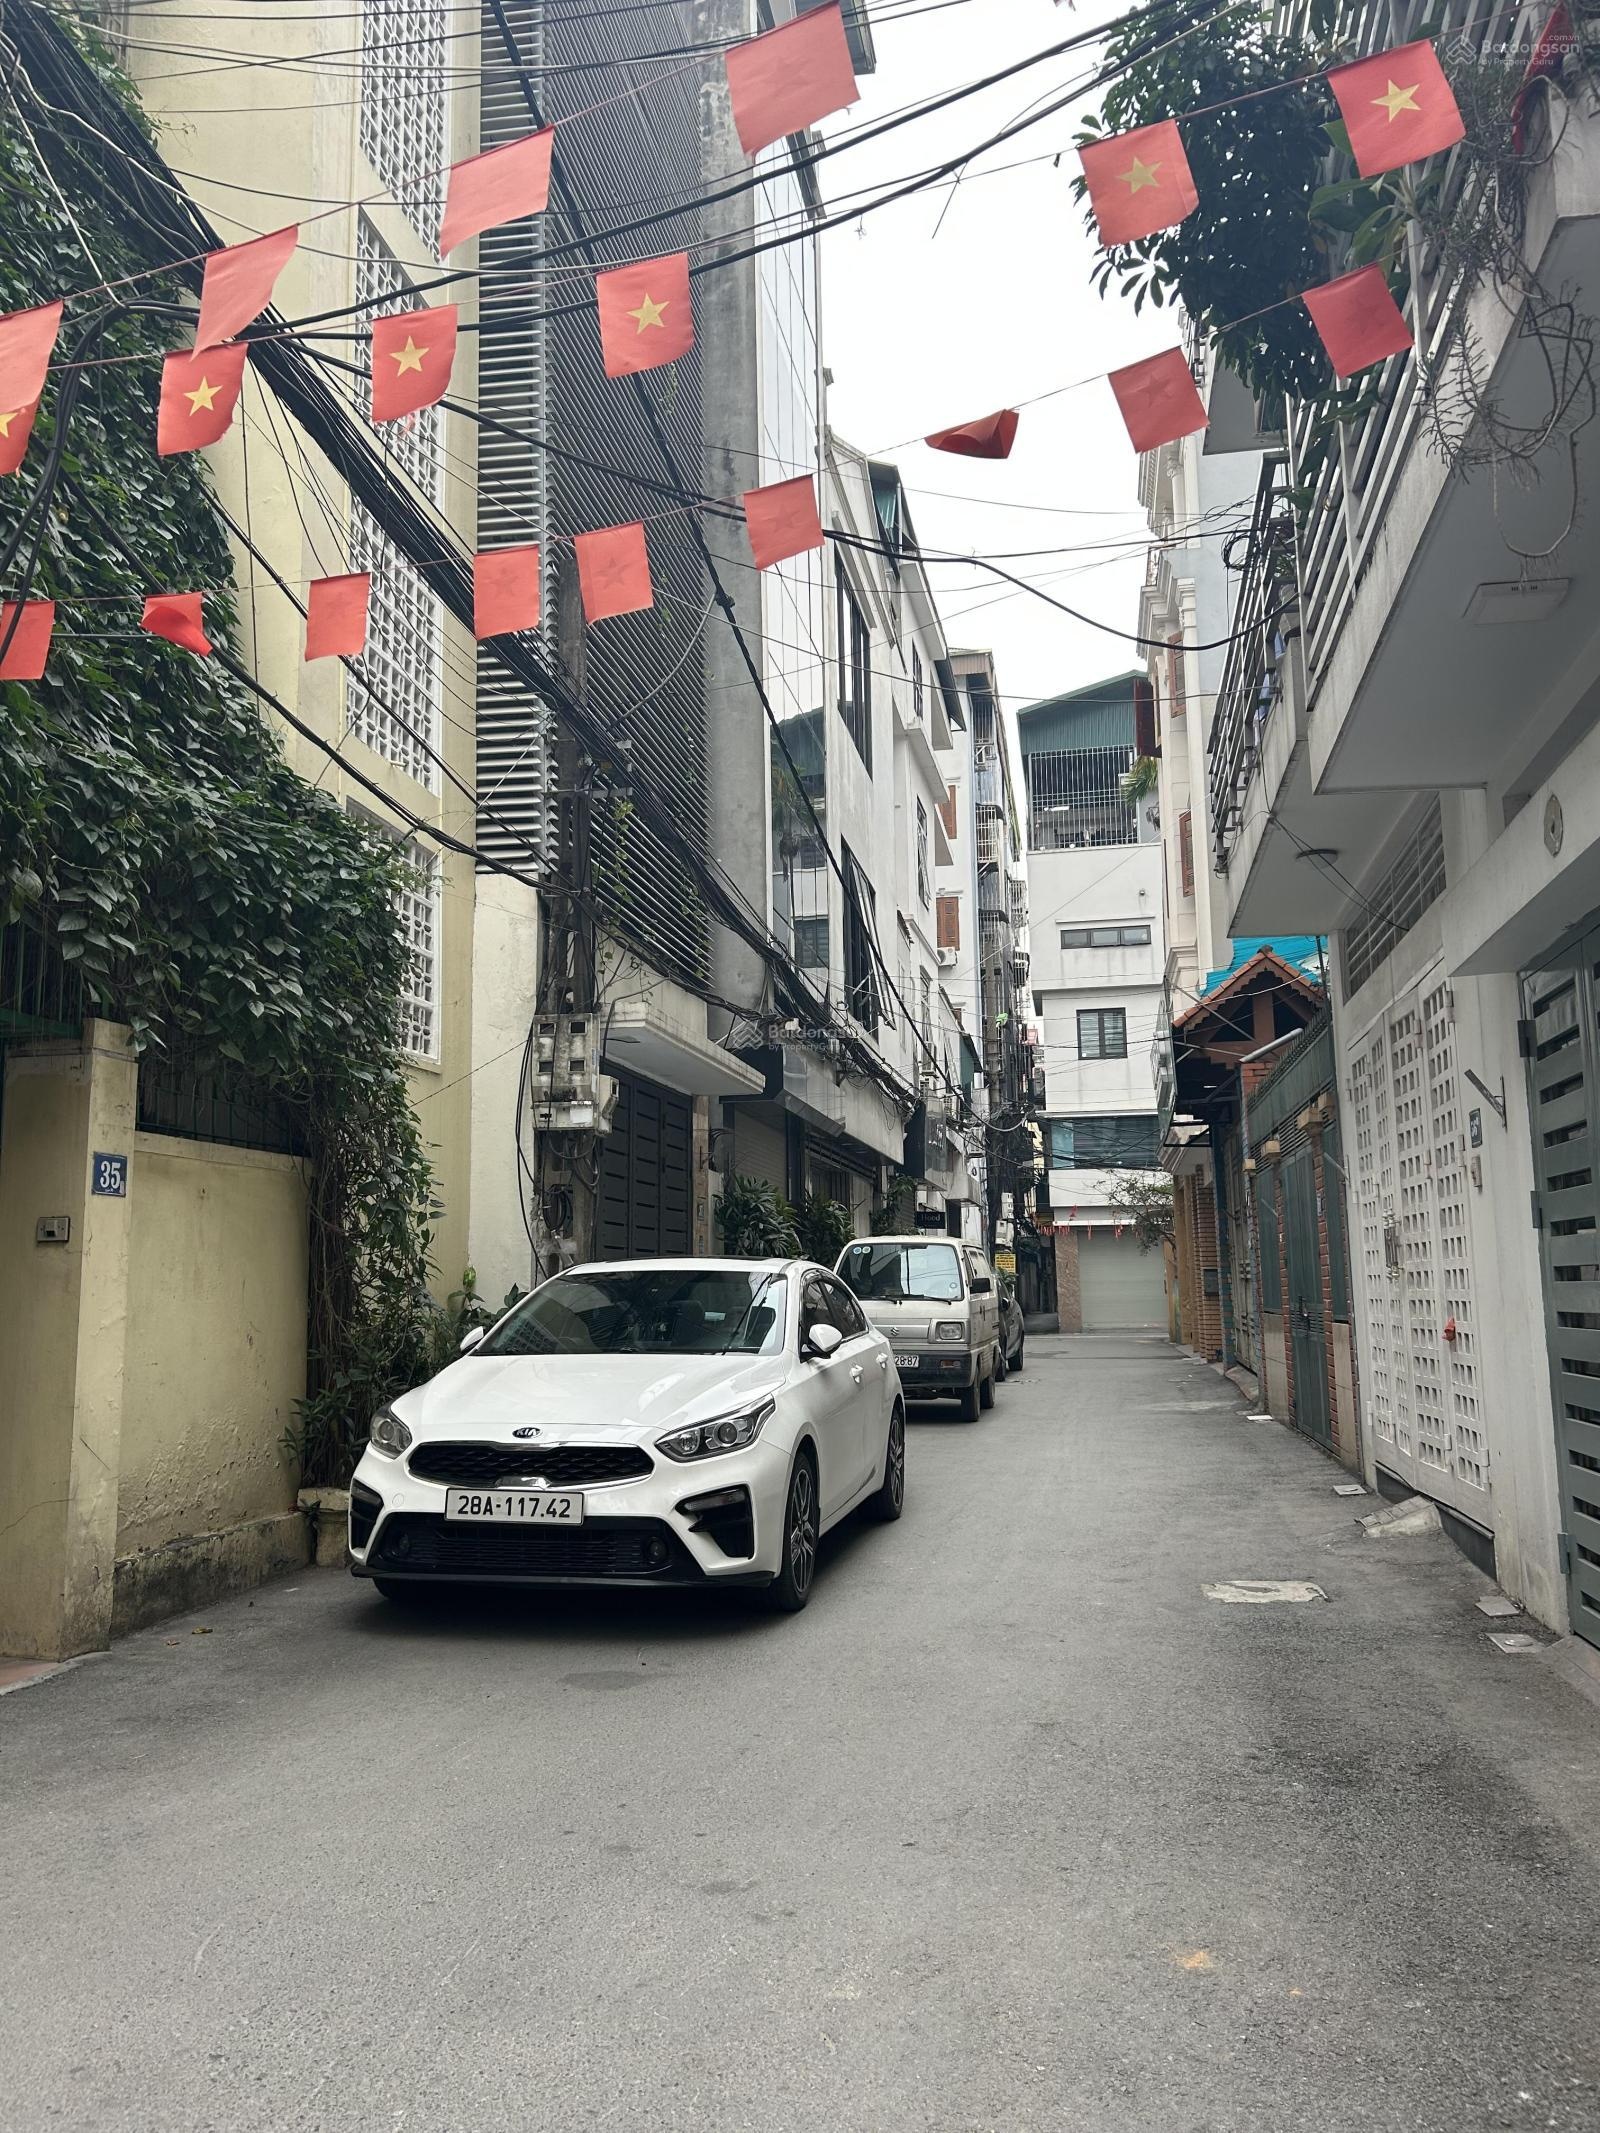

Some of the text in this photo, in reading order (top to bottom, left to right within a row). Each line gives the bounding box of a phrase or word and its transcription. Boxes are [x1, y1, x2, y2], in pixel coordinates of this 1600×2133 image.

[100, 1160, 121, 1189] 35
[515, 1428, 539, 1437] KIA
[457, 1495, 571, 1518] 28A-117.42
